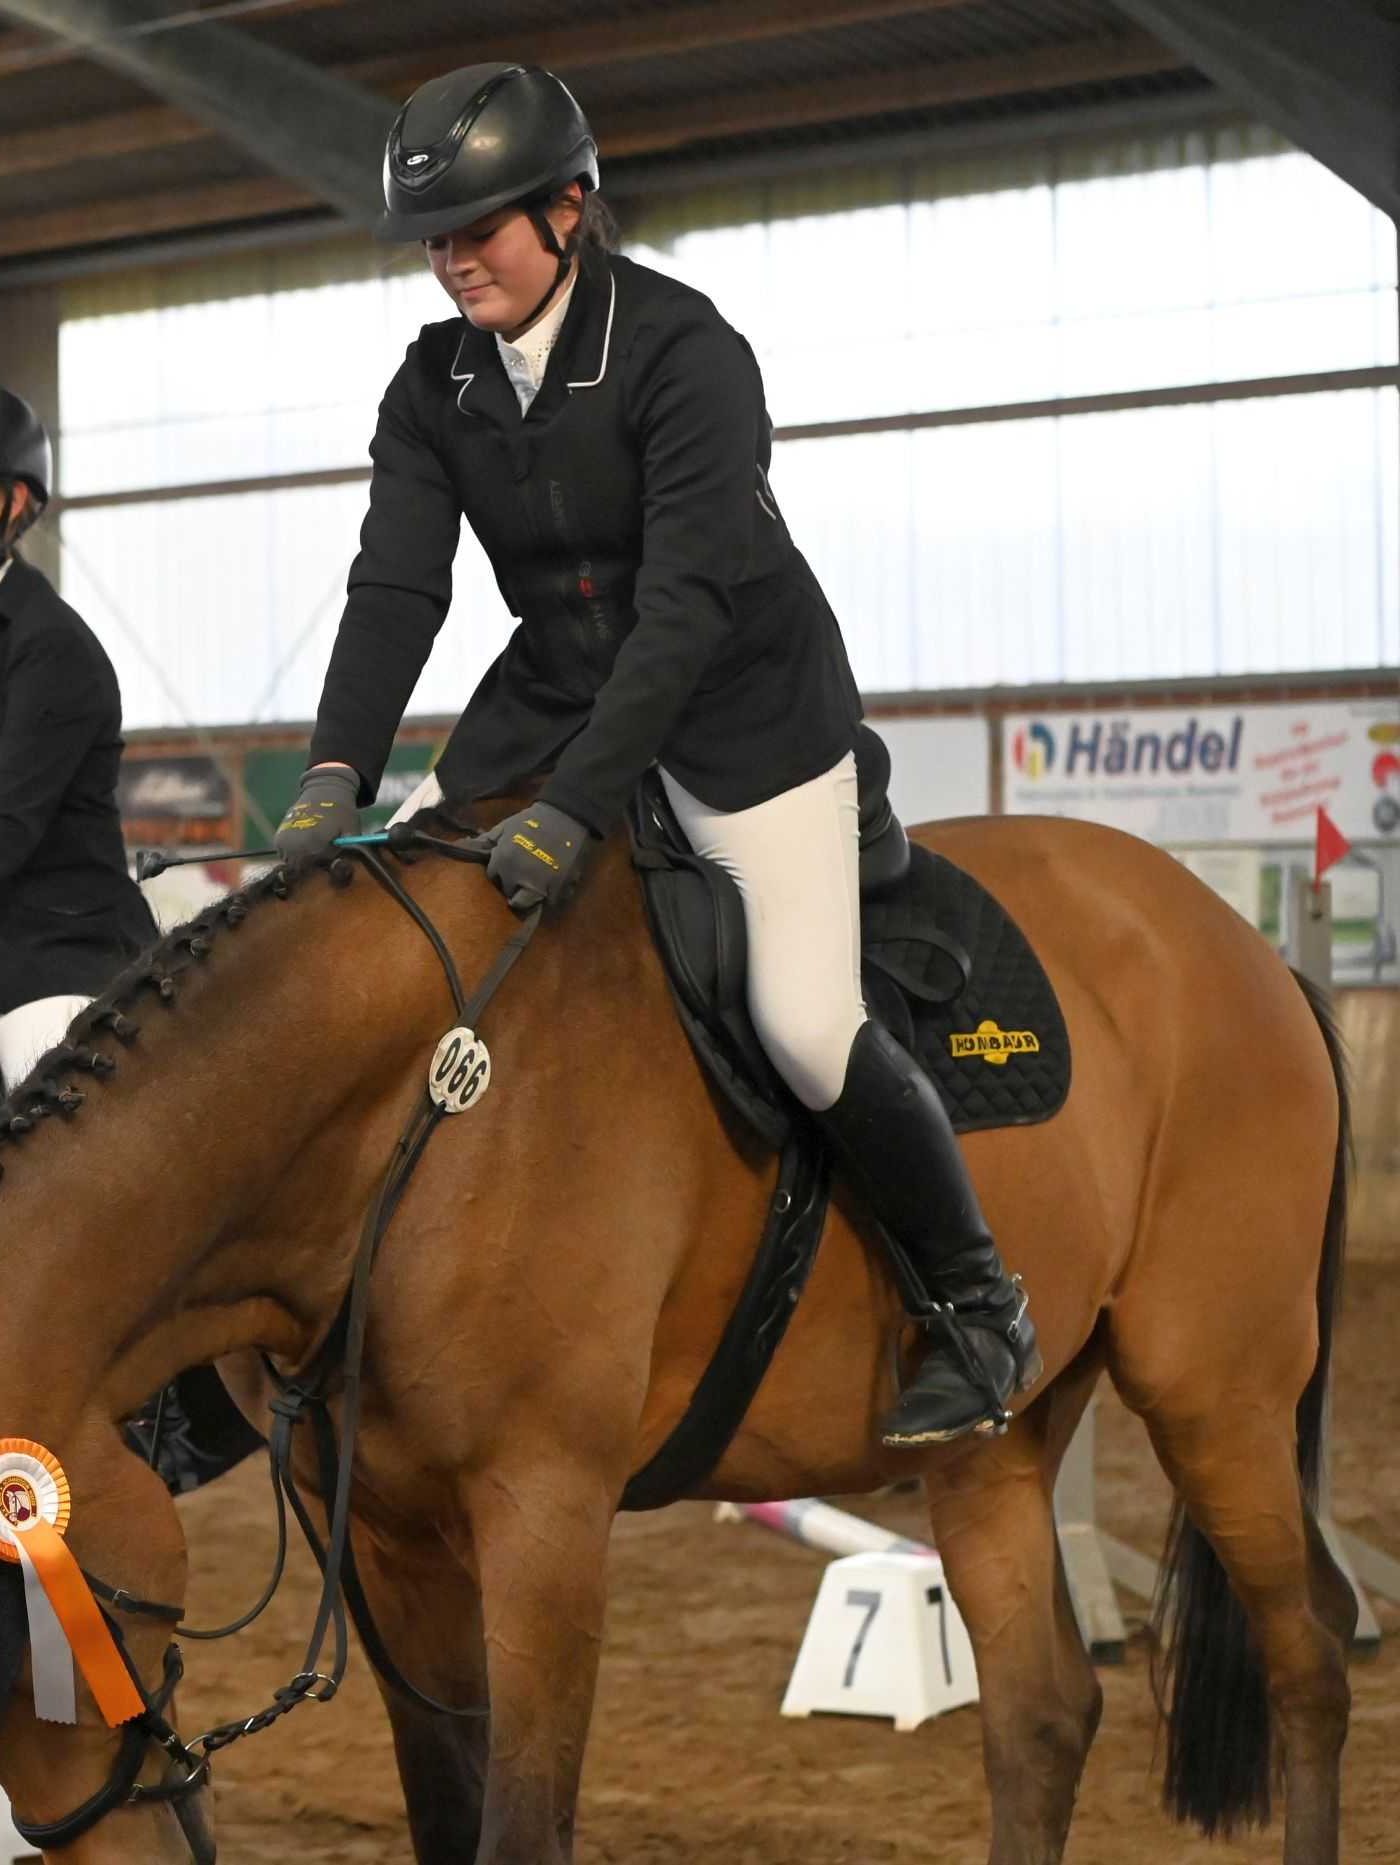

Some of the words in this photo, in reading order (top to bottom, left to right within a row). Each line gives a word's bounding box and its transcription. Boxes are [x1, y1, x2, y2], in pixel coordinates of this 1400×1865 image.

[1064, 715, 1243, 776] Händel
[435, 1037, 487, 1104] 066
[843, 1590, 882, 1687] 7
